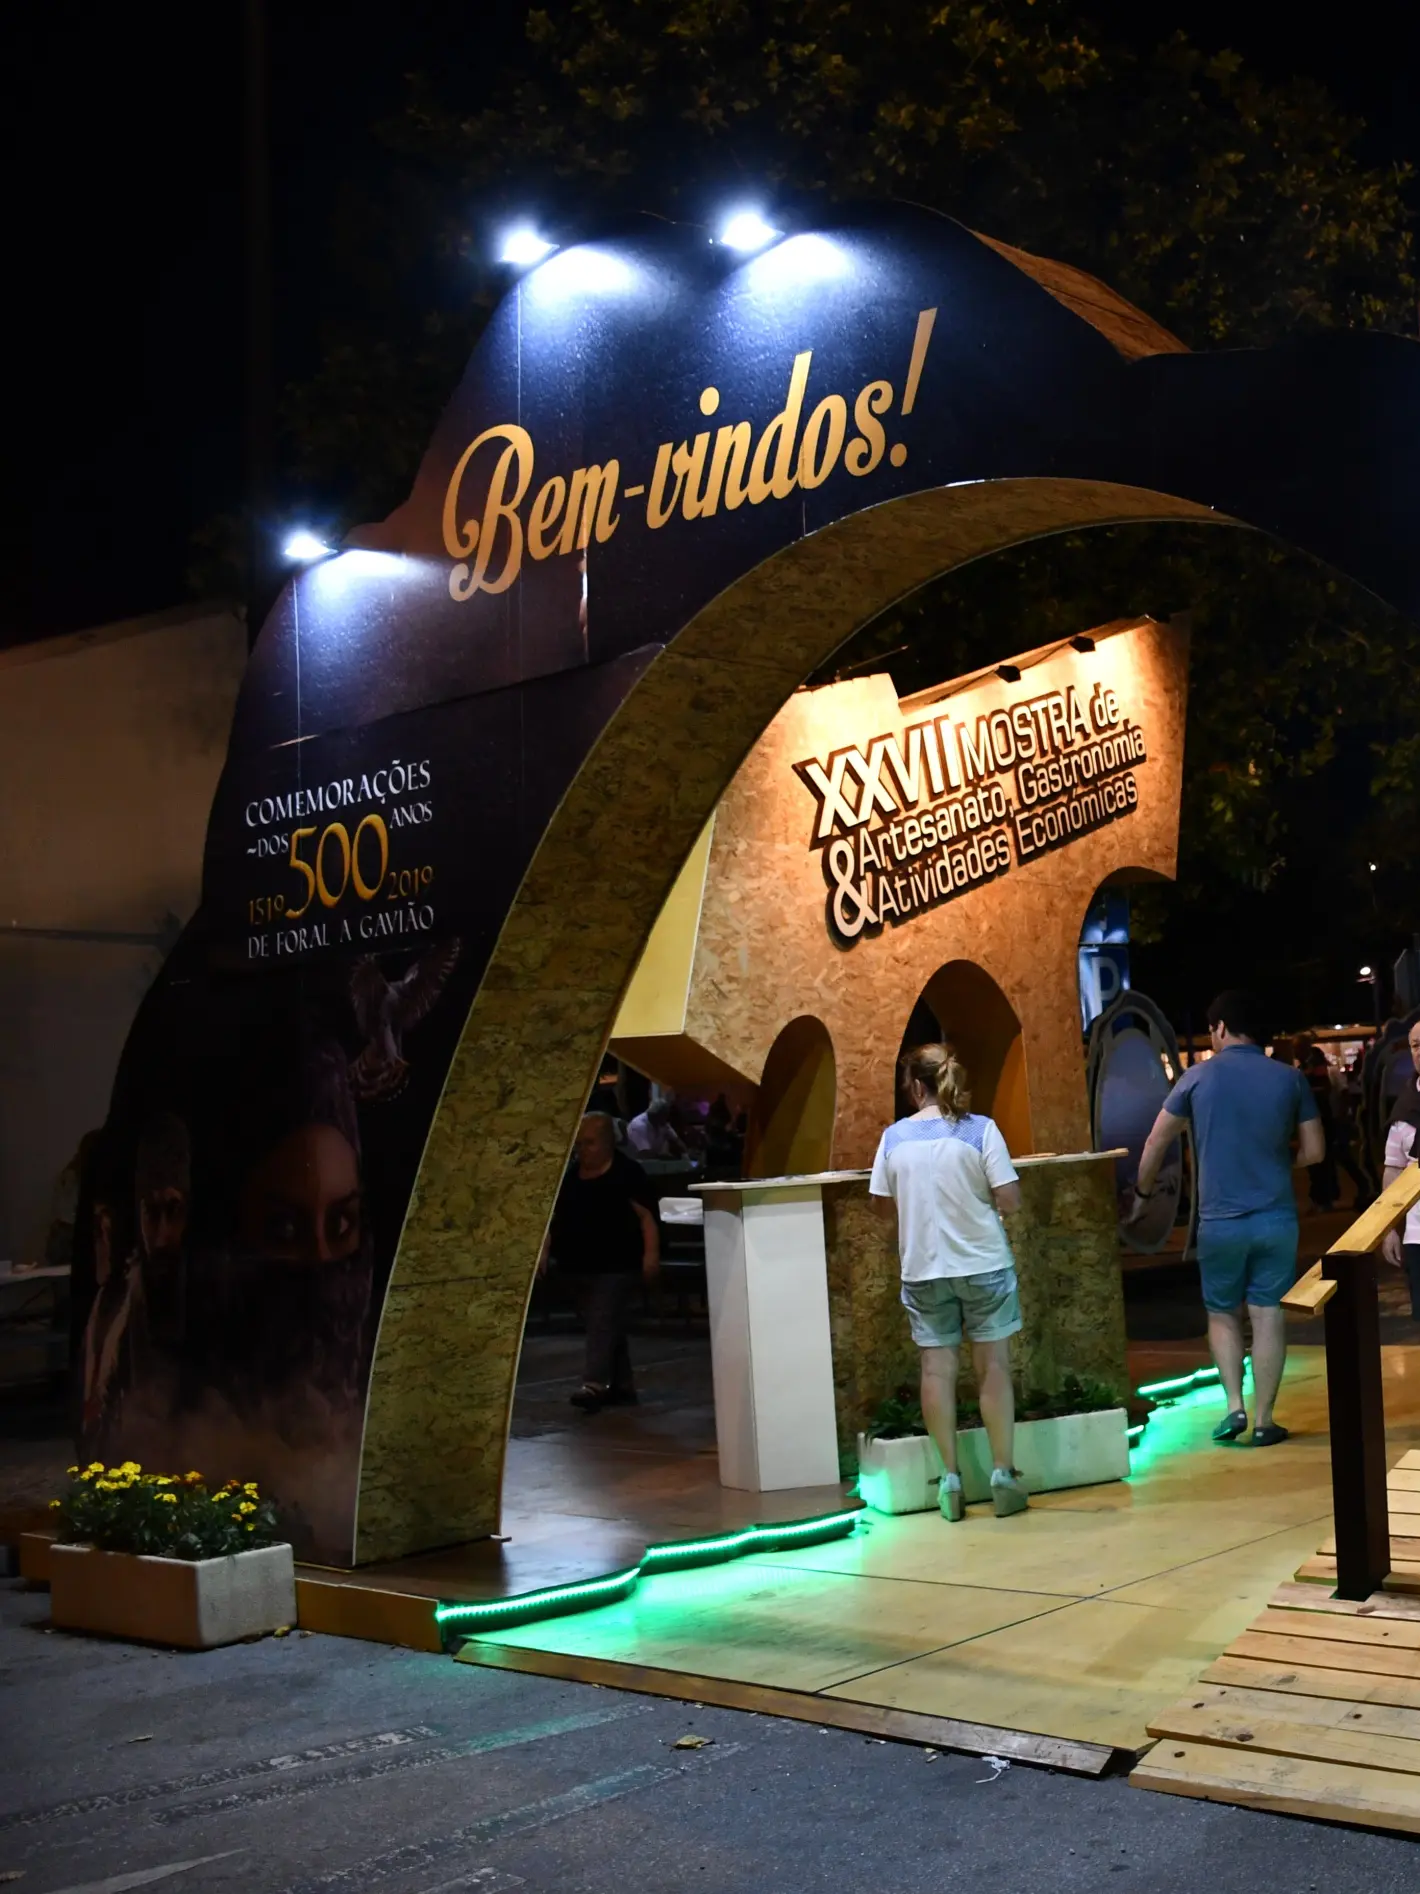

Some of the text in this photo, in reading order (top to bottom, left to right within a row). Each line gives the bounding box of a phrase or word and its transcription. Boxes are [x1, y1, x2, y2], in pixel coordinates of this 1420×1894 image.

[442, 307, 938, 602] Bem-vindos!
[245, 759, 431, 827] COMEMORAÇÕES
[804, 686, 1120, 839] XXVII MOSTRA de
[859, 727, 1146, 877] Artesanato, Gastronomia
[285, 813, 389, 920] 500
[389, 800, 433, 829] ANOS
[828, 775, 1138, 937] & Atividades Económicas
[248, 902, 435, 959] DE FORAL A GAVIÃO
[1091, 956, 1121, 1018] P
